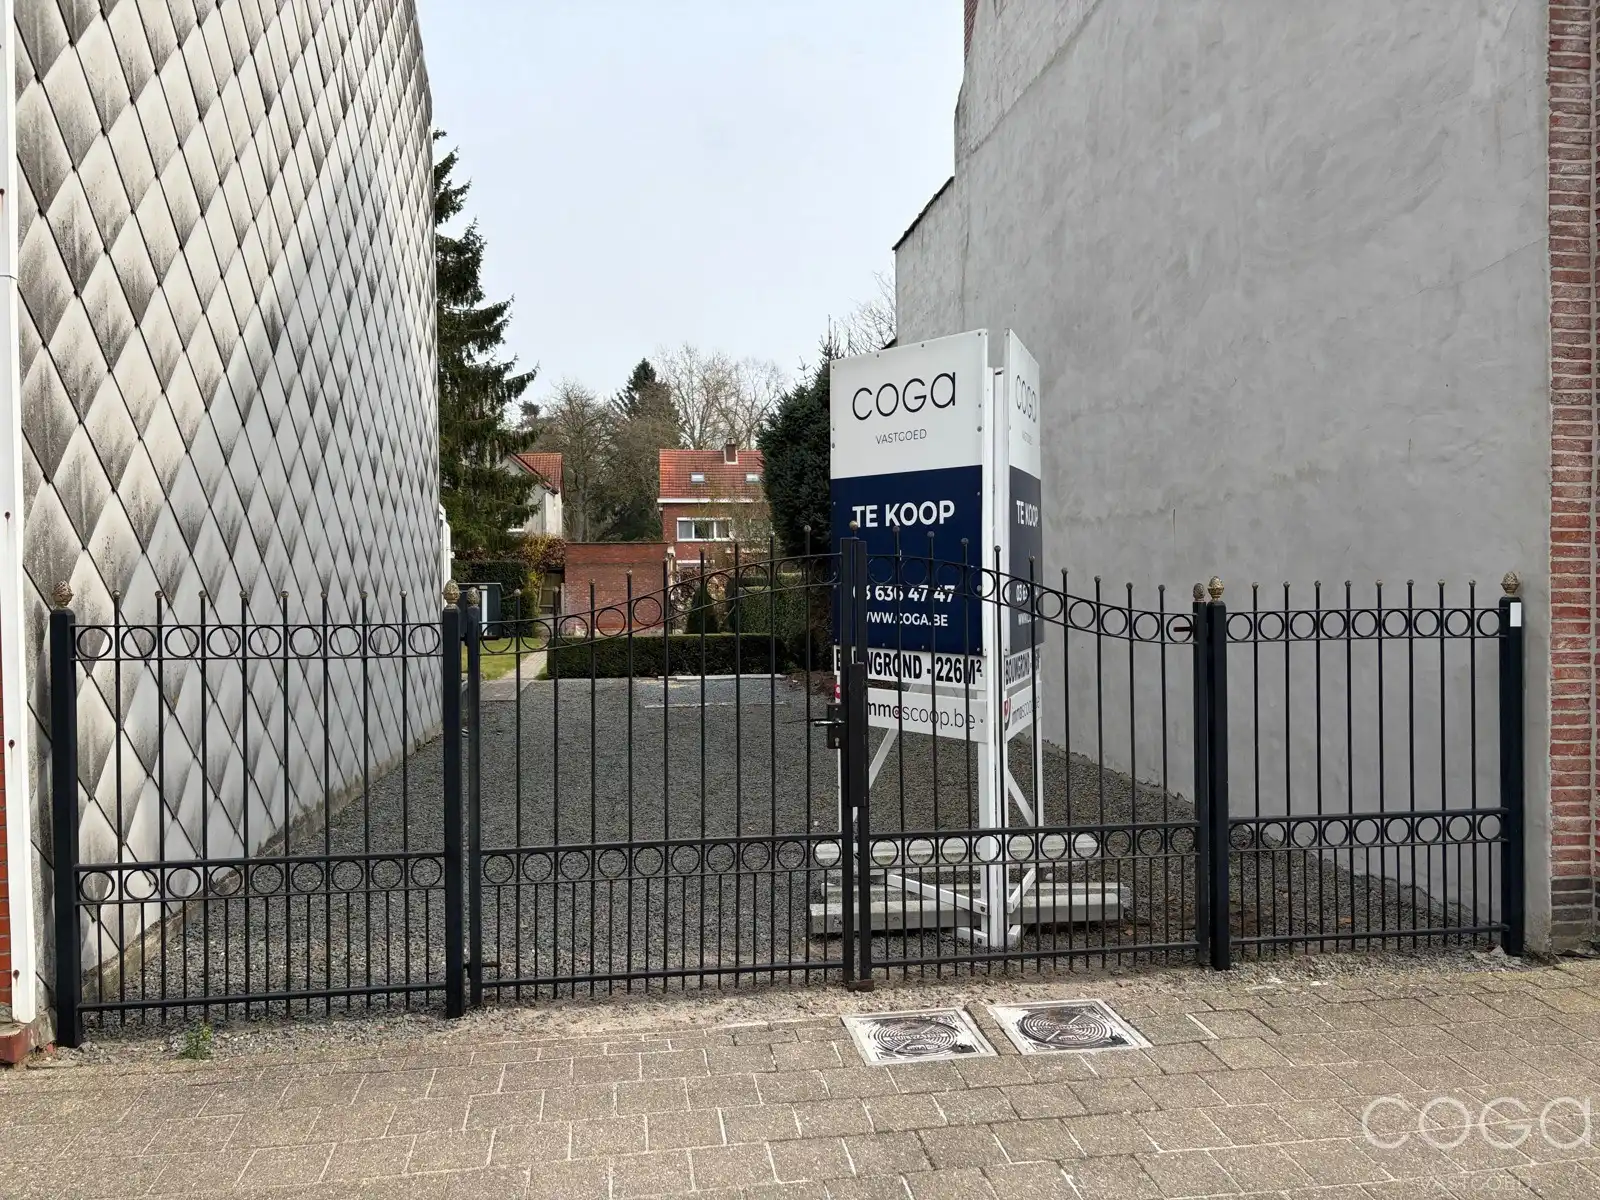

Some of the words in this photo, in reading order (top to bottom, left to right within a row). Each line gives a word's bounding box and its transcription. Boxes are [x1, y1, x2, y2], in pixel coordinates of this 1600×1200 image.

[875, 428, 927, 445] VASTGOED
[852, 504, 878, 528] TE
[885, 500, 955, 526] KOOP
[1016, 500, 1025, 525] TE
[908, 584, 929, 602] 47
[933, 584, 955, 603] 47
[836, 649, 922, 681] BGROND
[867, 702, 976, 730] mmoscoop.be
